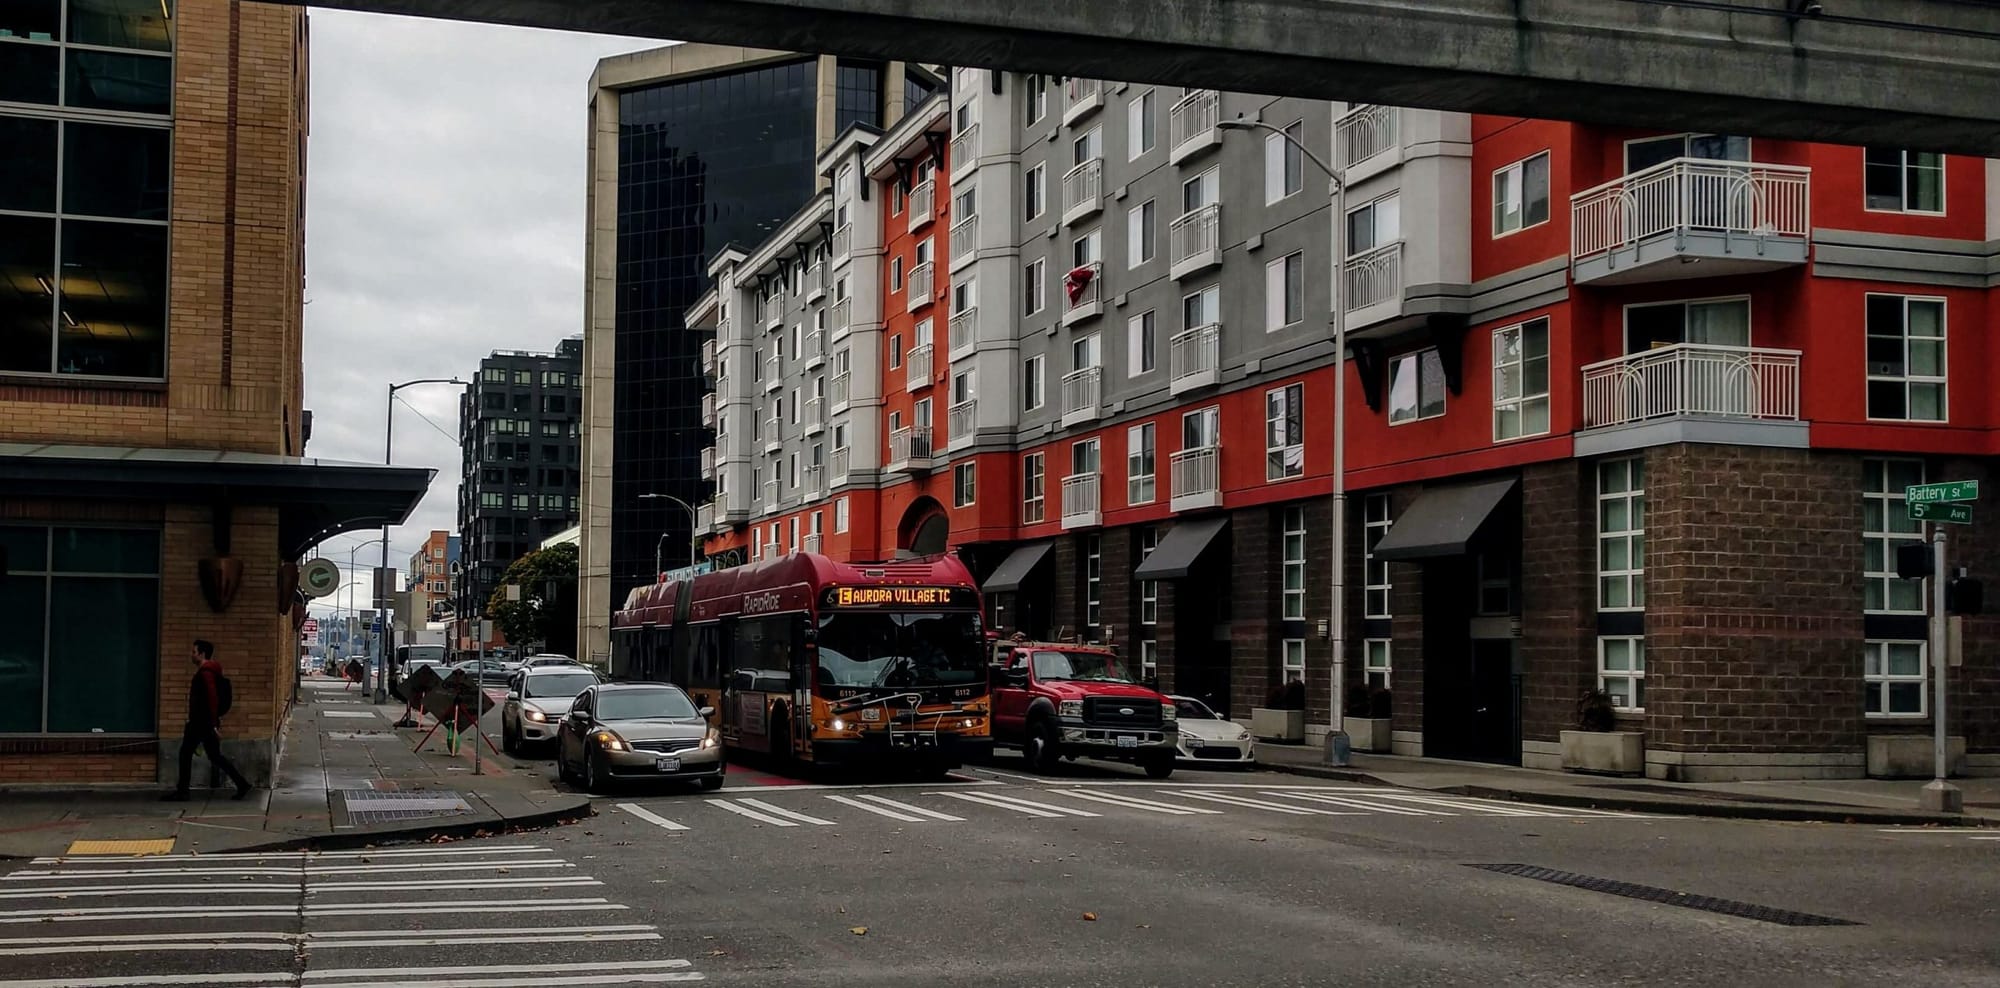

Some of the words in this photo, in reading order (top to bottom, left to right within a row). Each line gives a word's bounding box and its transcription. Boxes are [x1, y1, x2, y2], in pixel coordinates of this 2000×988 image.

[1909, 487, 1947, 500] Battery
[1952, 487, 1960, 497] St
[1951, 509, 1966, 519] Ave
[841, 589, 851, 603] E
[853, 590, 892, 602] AURORA
[895, 589, 936, 603] VILLAGE
[939, 589, 951, 602] TC
